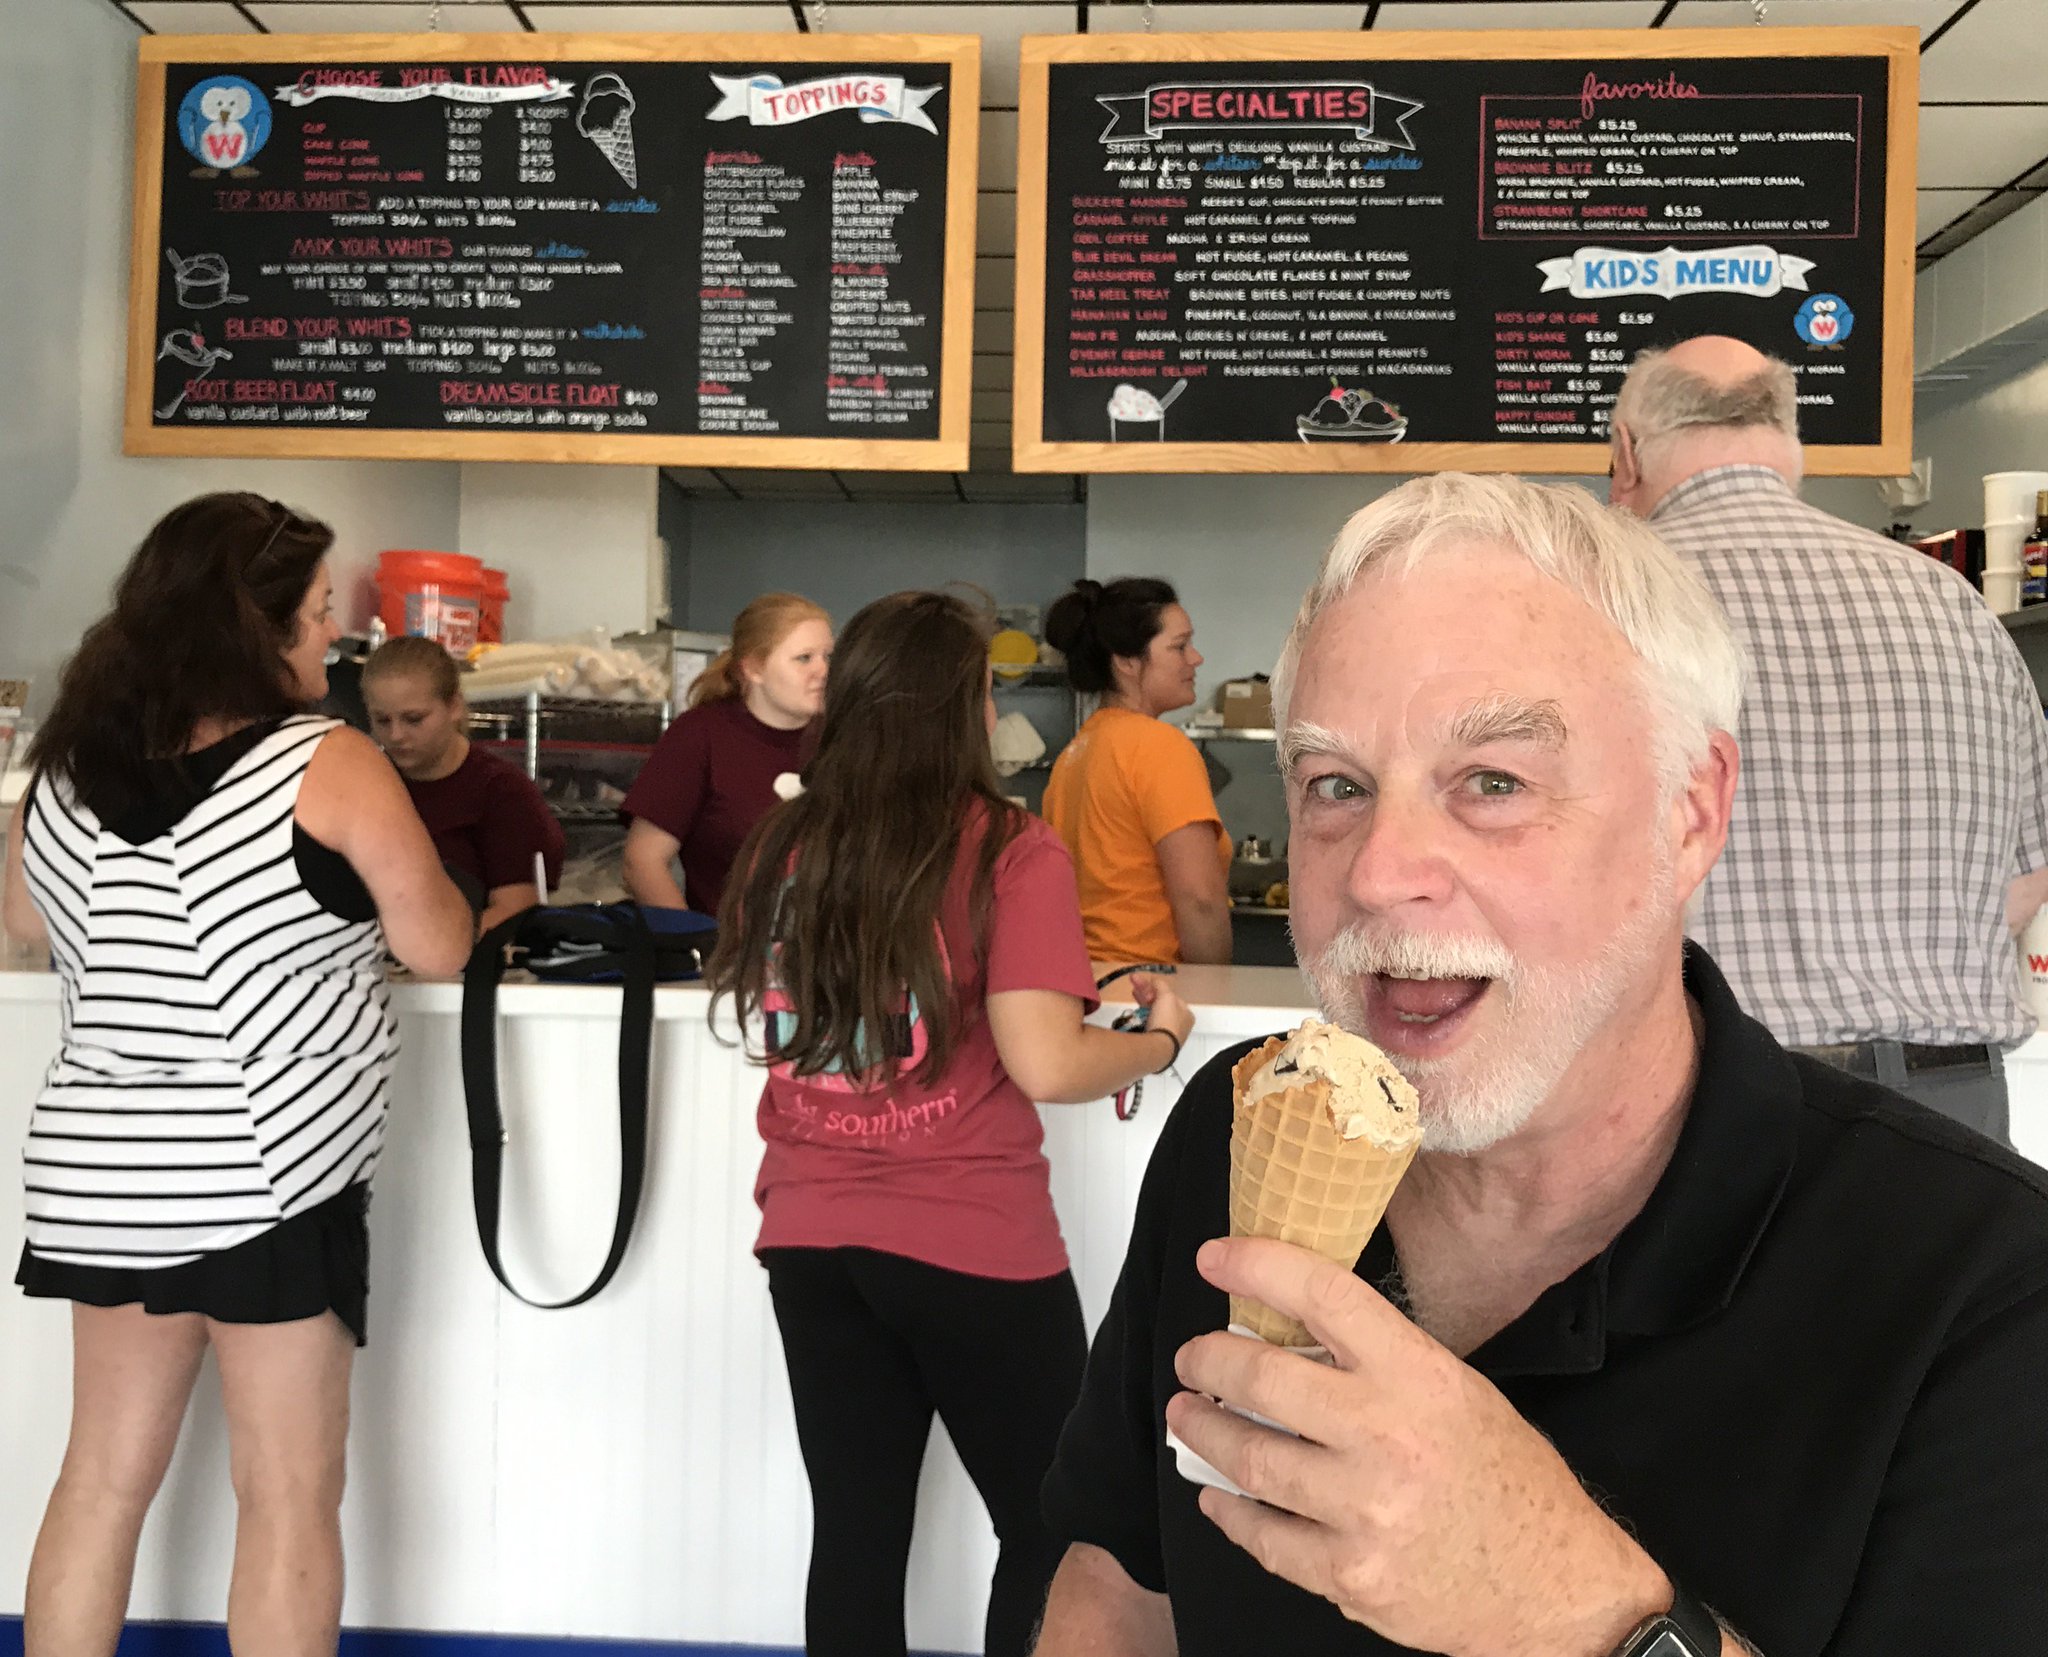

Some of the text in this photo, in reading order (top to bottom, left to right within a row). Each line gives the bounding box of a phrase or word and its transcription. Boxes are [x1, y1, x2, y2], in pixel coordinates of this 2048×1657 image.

[300, 69, 382, 95] CHOOSE
[400, 68, 450, 86] YOUR
[464, 66, 552, 90] FLAVOR
[764, 81, 886, 120] TOPPINGS
[1581, 71, 1699, 120] favorites
[1151, 91, 1369, 119] SPECIALTIES
[206, 134, 243, 160] W
[1496, 134, 1539, 144] WHOLE
[1588, 134, 1628, 143] VANILLA
[1677, 133, 1734, 143] CHOCOLATE
[1106, 143, 1150, 154] STARTS
[1154, 142, 1184, 153] WITH
[1287, 141, 1334, 153] VANILLA
[1339, 142, 1390, 153] CUSTARD
[833, 167, 871, 177] APPLE
[1119, 177, 1150, 189] MINI
[1204, 177, 1245, 189] SMALL
[1293, 177, 1345, 189] REGULAR
[257, 191, 296, 210] YOUR
[1184, 215, 1206, 226] HOT
[1274, 214, 1306, 225] APPLE
[1310, 214, 1357, 224] TOPPING
[1166, 233, 1208, 244] MOCHA
[1271, 233, 1311, 244] CREAM
[340, 239, 381, 256] YOUR
[1195, 251, 1221, 262] HOT
[1268, 252, 1291, 262] HOT
[1366, 252, 1409, 262] PECANS
[1174, 271, 1206, 281] SOFT
[1211, 270, 1278, 281] CHOCOLATE
[1282, 270, 1326, 281] FLAKES
[1340, 270, 1370, 281] MINT
[1376, 270, 1412, 281] SYRUP
[1584, 259, 1772, 289] KID'S MENU
[1189, 289, 1246, 301] BROWNIE
[1420, 290, 1451, 300] NUTS
[225, 318, 288, 336] BLEND
[294, 318, 340, 336] YOUR
[1813, 321, 1836, 336] W
[299, 338, 336, 355] small
[382, 338, 436, 355] medium
[483, 340, 516, 362] large
[1497, 363, 1537, 373] VANILLA
[1539, 363, 1583, 373] CUSTARD
[185, 380, 229, 400] ROOT
[234, 381, 277, 400] BEER
[281, 381, 336, 401] FLOAT
[440, 382, 561, 404] DREAMSICLE
[567, 384, 620, 405] FLOAT
[186, 405, 226, 420] vanilla
[229, 405, 279, 420] custard
[444, 407, 647, 431] vanilla custard with orange soda
